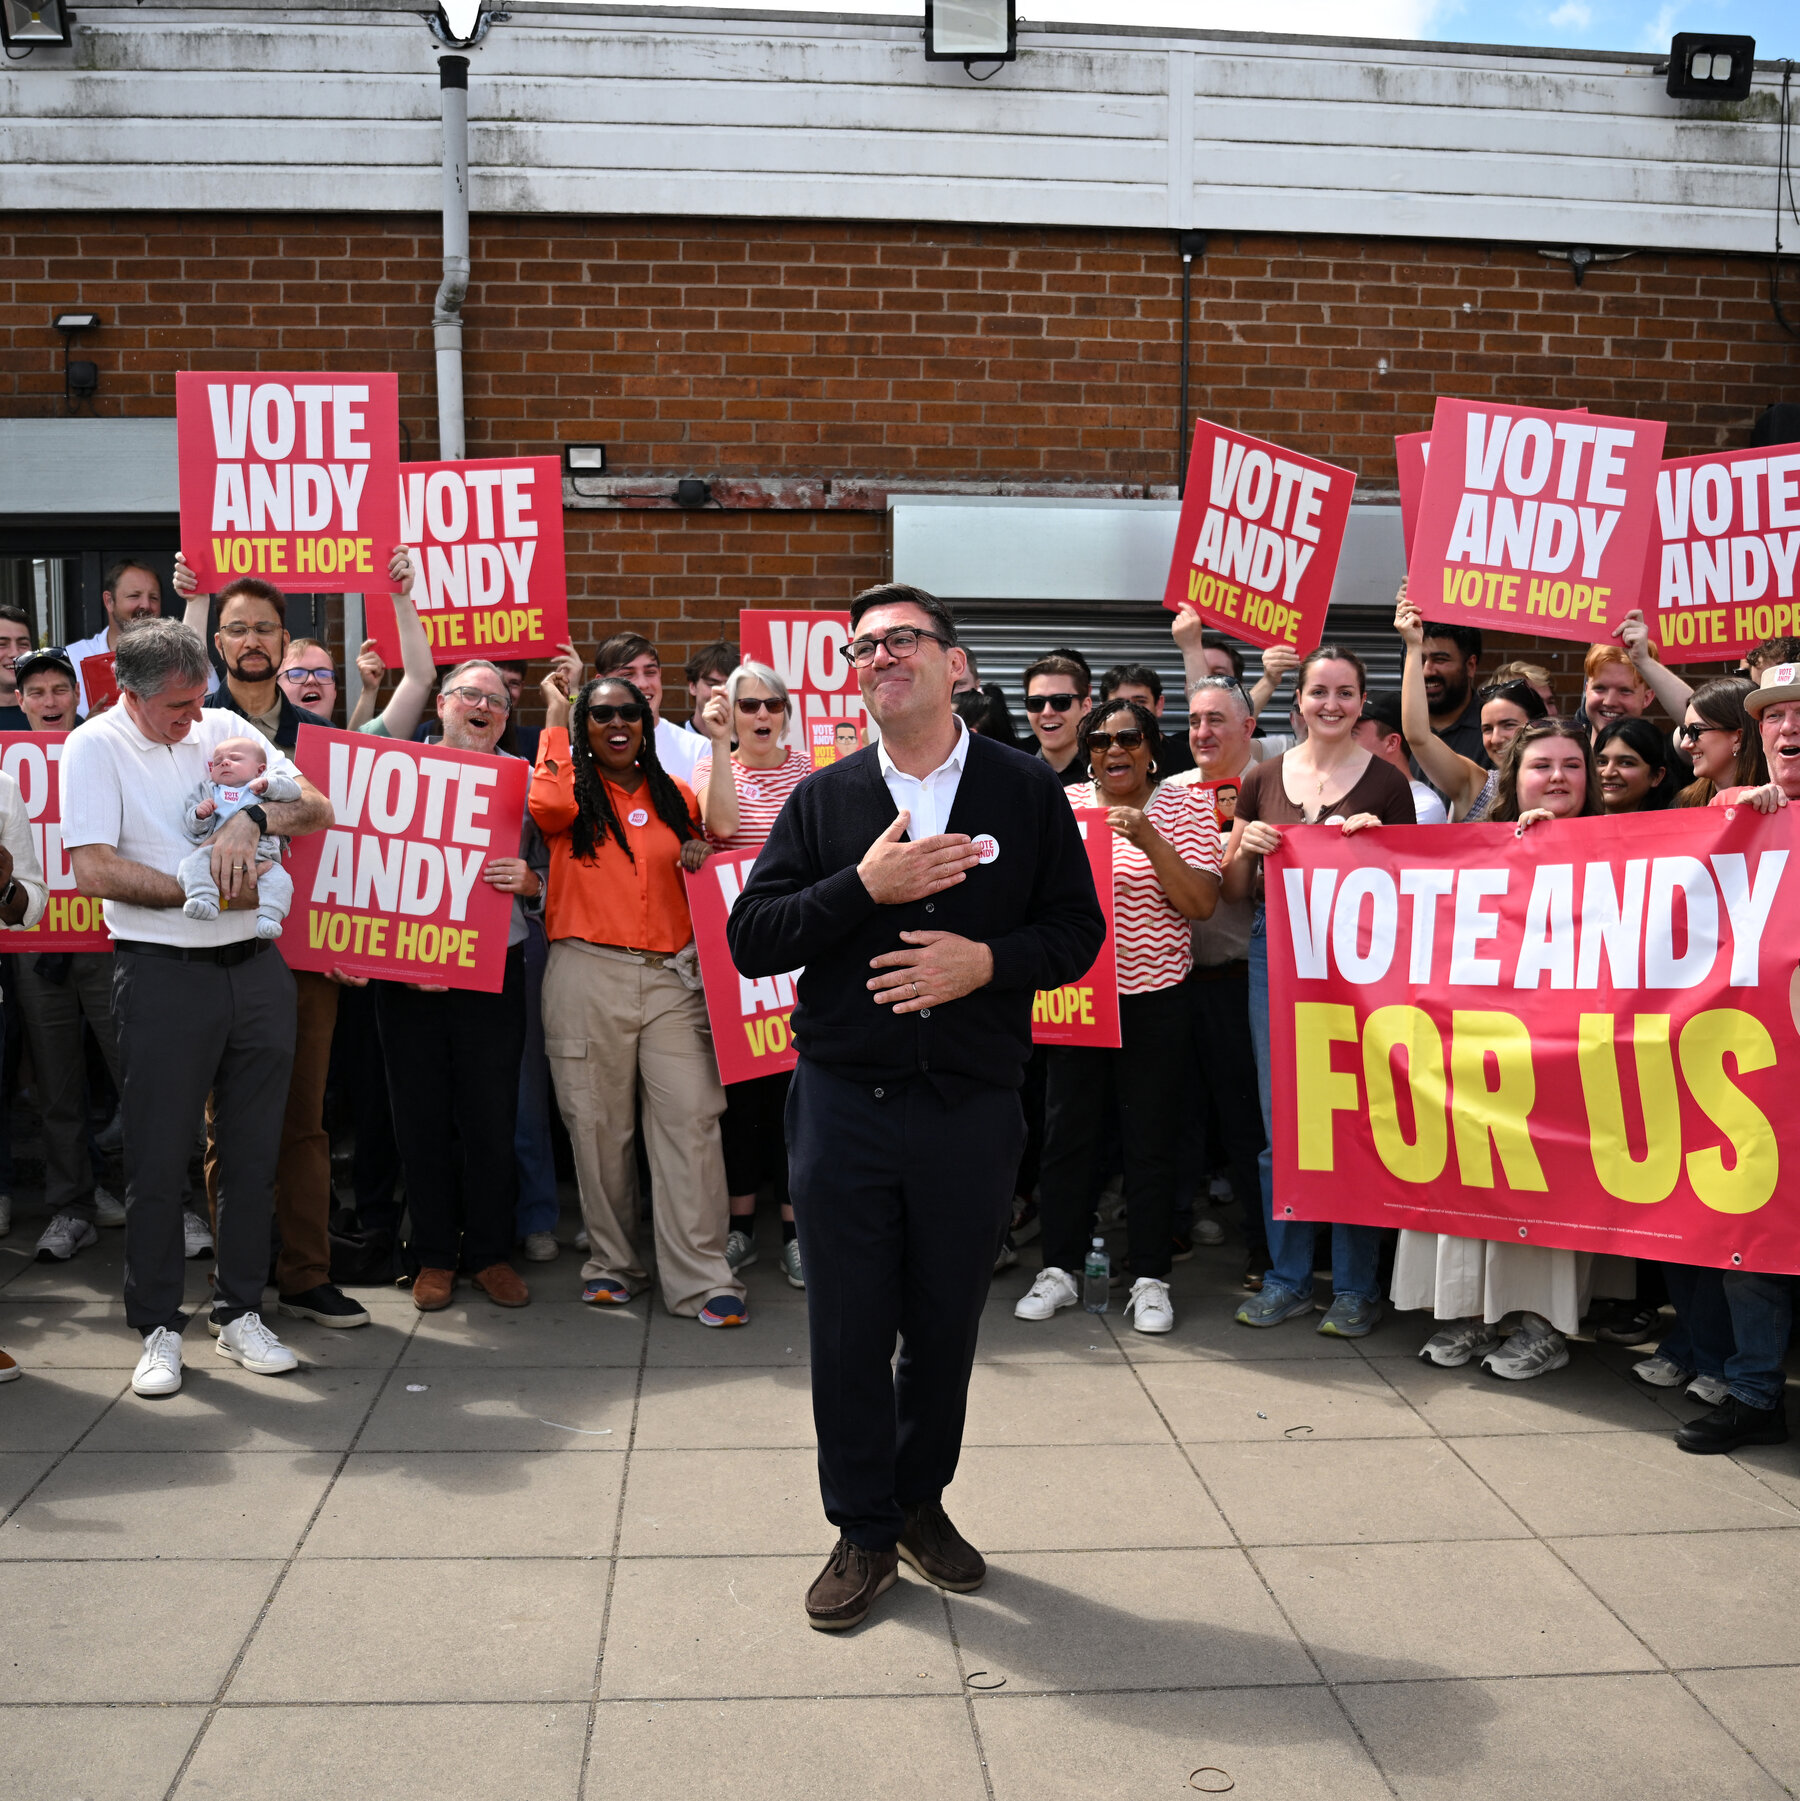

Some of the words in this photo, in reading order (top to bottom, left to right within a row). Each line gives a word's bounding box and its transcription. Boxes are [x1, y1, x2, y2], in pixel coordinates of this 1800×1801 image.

[207, 383, 371, 460] VOTE
[1209, 436, 1331, 544] VOTE
[1465, 412, 1635, 507] VOTE
[211, 463, 369, 532] ANDY
[399, 467, 538, 543] VOTE
[1656, 454, 1800, 540] VOTE
[212, 537, 288, 573] VOTE
[296, 537, 374, 573] HOPE
[1192, 507, 1315, 604] ANDY
[1445, 493, 1621, 580] ANDY
[1658, 530, 1800, 608] ANDY
[416, 614, 467, 648] OTE
[473, 608, 545, 645] HOPE
[1187, 569, 1242, 619] VOTE
[1243, 595, 1303, 645] HOPE
[1443, 567, 1521, 613] VOTE
[1525, 578, 1612, 624] HOPE
[1658, 609, 1727, 647] VOTE
[1779, 668, 1792, 676] VOTE
[812, 724, 834, 736] VOTE
[813, 735, 835, 745] ANDY
[814, 746, 836, 757] VOTE
[329, 742, 498, 847] VOTE
[311, 829, 486, 922] ANDY
[978, 840, 994, 849] OTE
[49, 896, 104, 932] HOP
[309, 909, 387, 957] VOTE
[395, 921, 479, 968] HOPE
[1282, 867, 1510, 986] VOTE
[1513, 850, 1790, 990] ANDY
[1032, 986, 1096, 1026] HOPE
[1294, 1001, 1549, 1193] FOR
[1577, 1007, 1779, 1215] US
